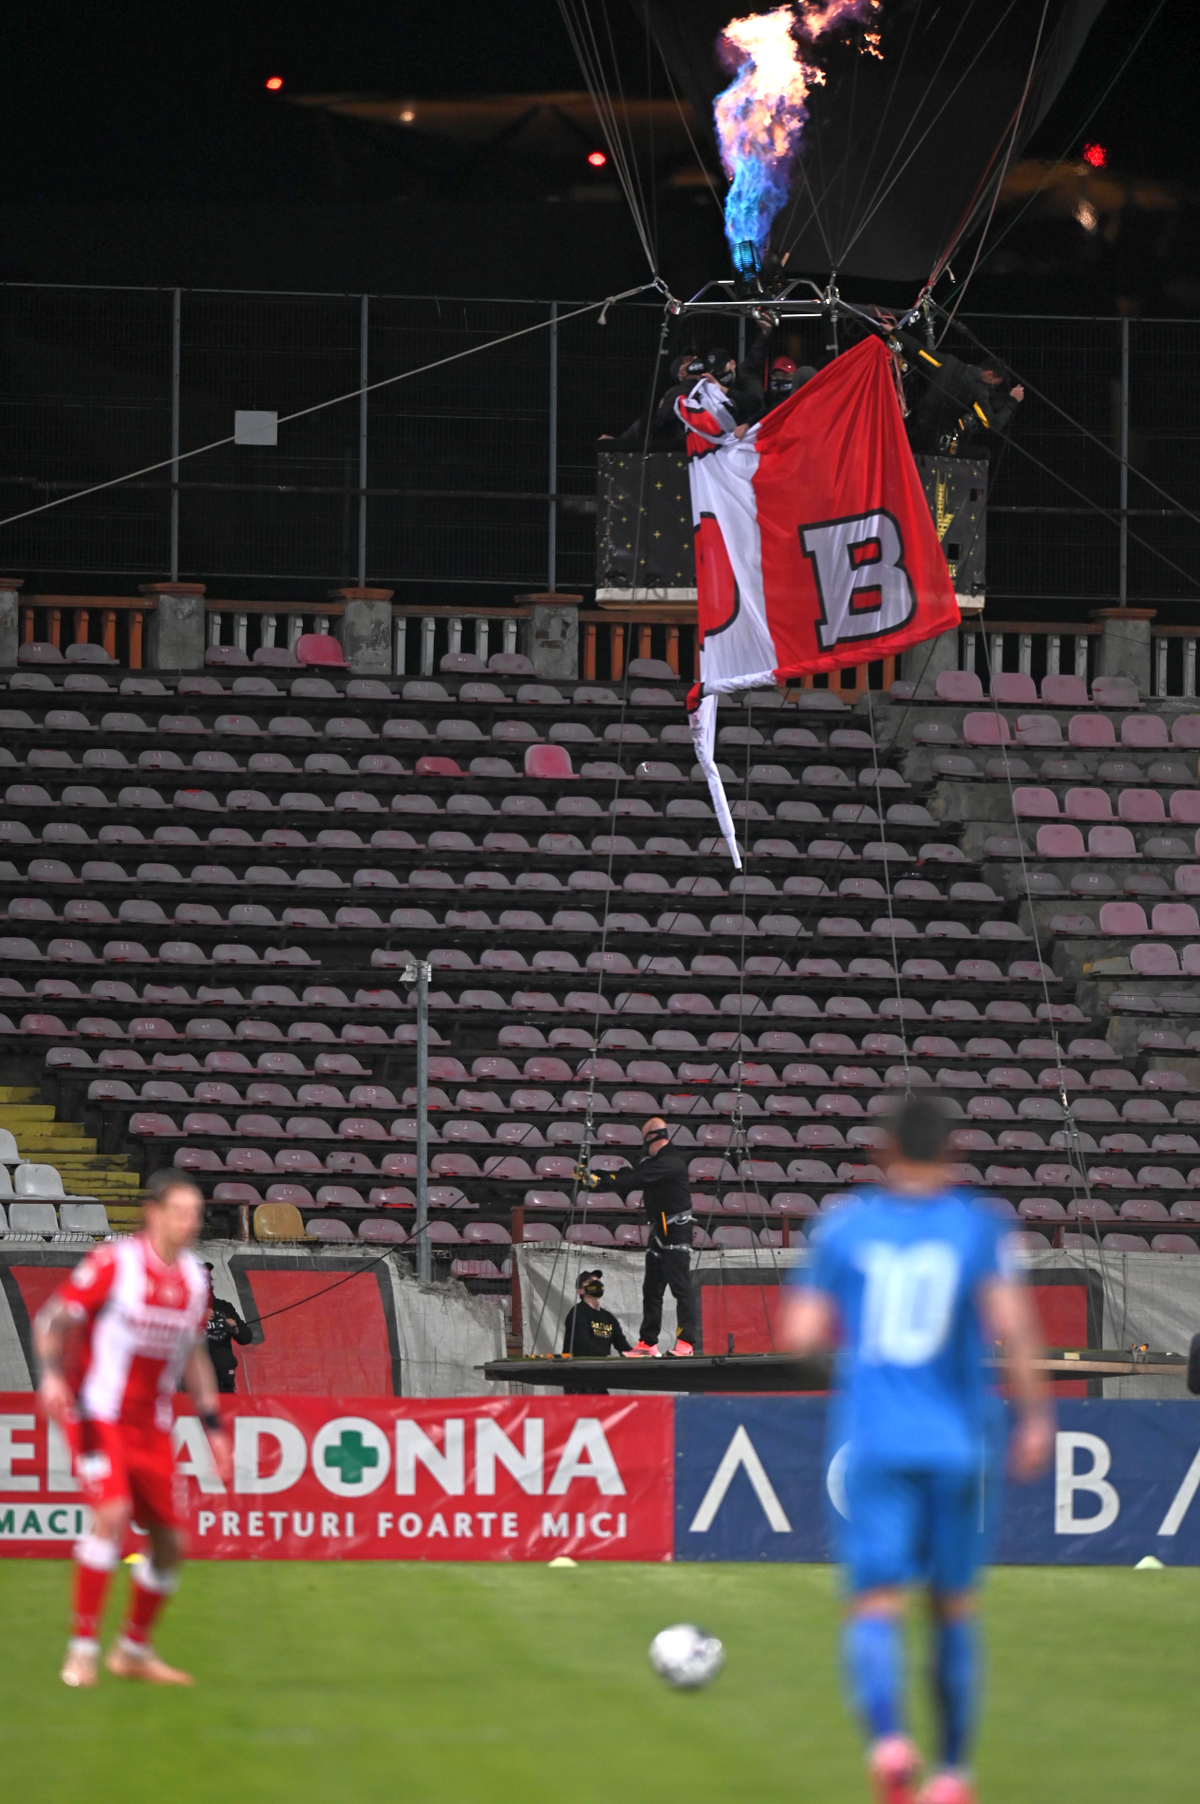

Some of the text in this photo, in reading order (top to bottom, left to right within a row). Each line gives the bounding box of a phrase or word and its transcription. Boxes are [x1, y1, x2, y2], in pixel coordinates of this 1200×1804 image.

[798, 507, 917, 653] B
[862, 1239, 959, 1366] 10
[0, 1414, 626, 1497] ELADONNA
[377, 1512, 519, 1538] FOARTE
[541, 1512, 627, 1538] MICI
